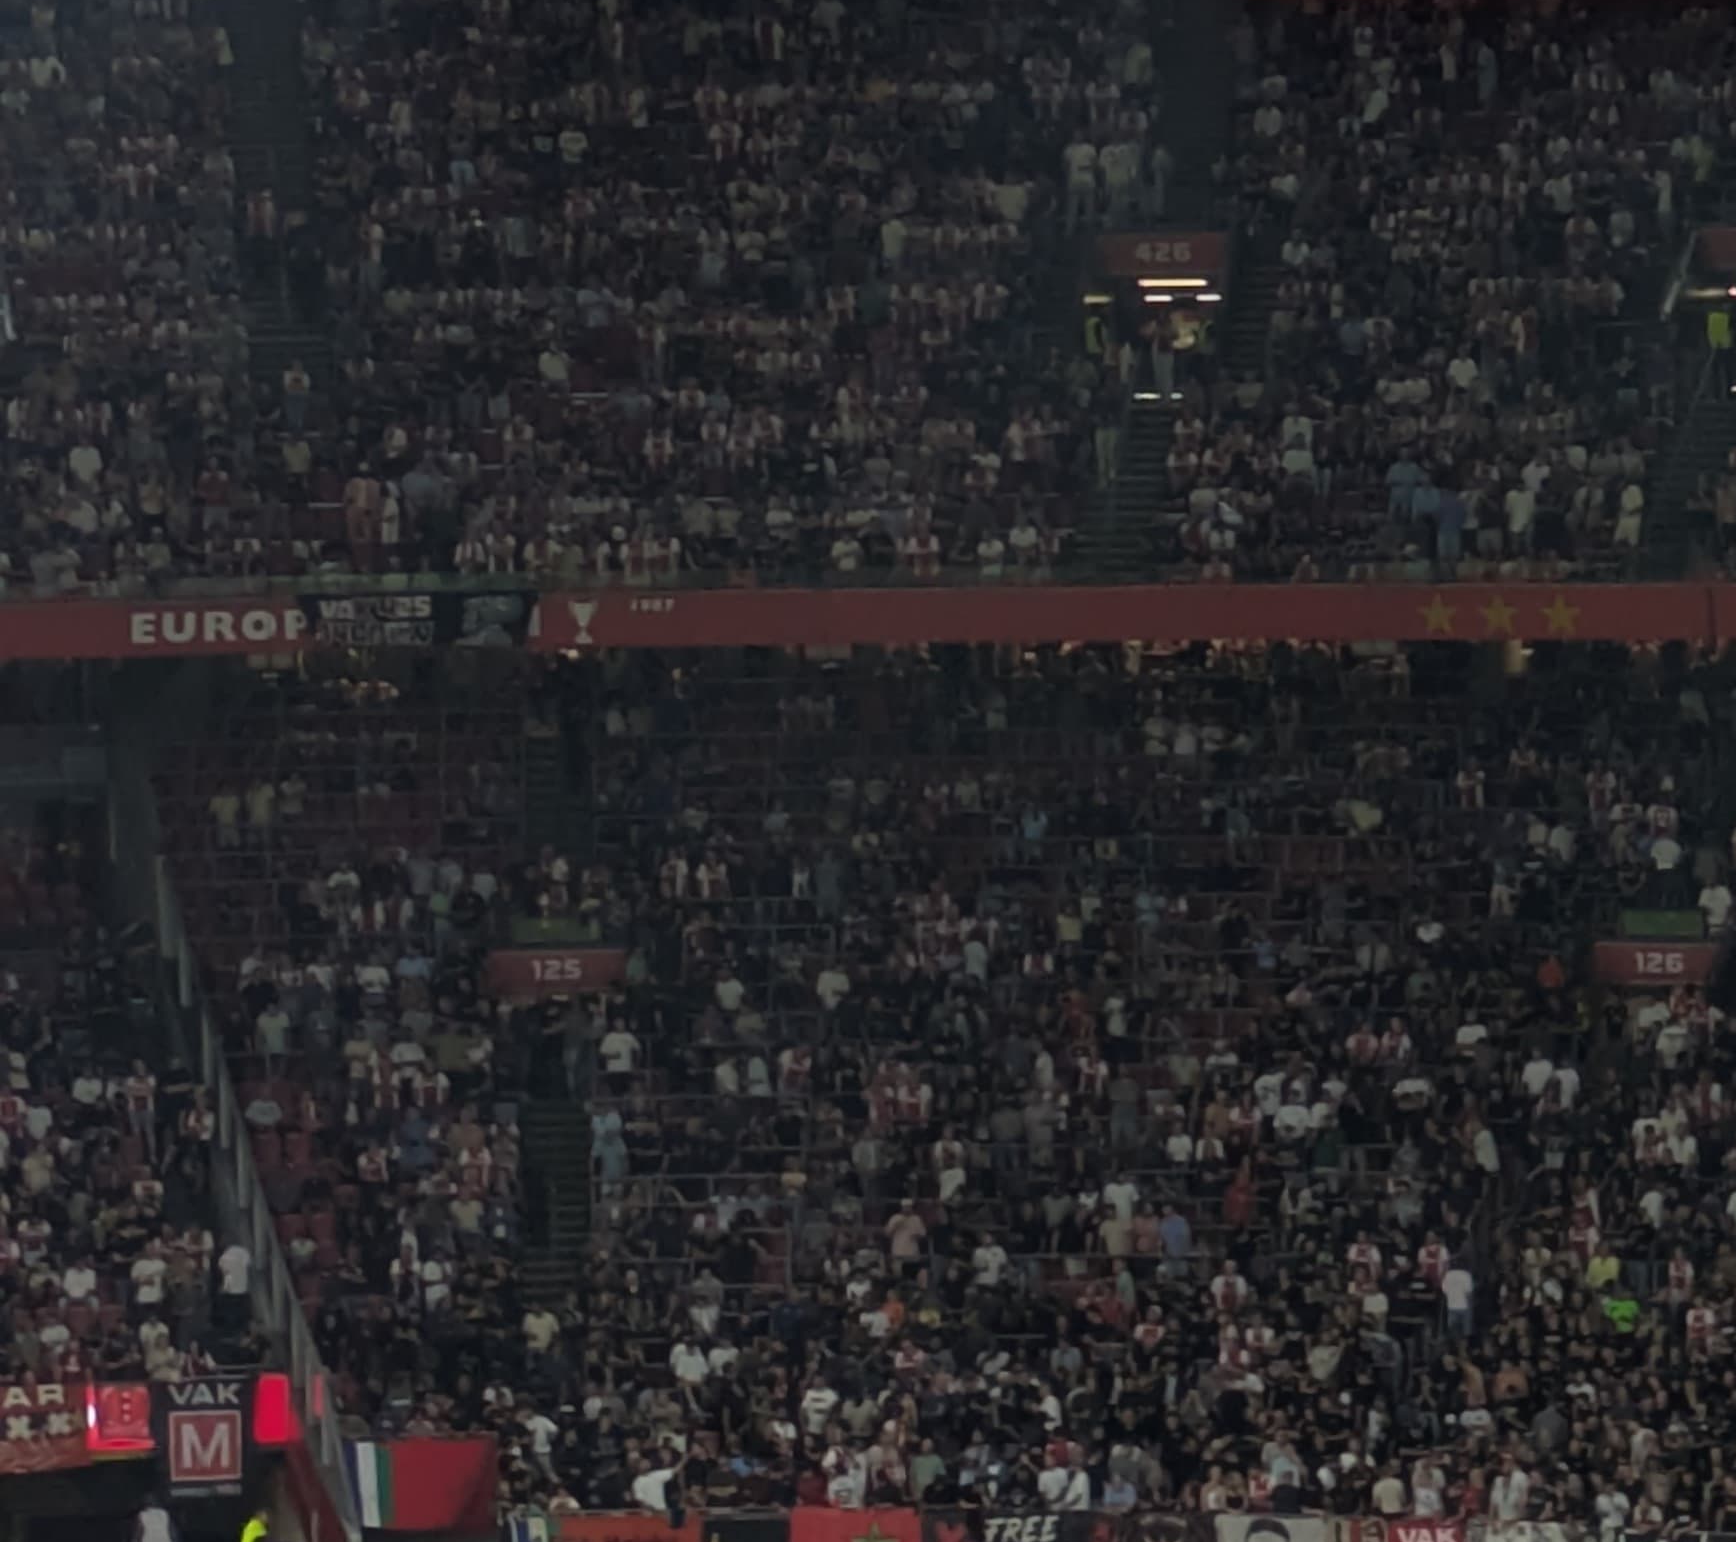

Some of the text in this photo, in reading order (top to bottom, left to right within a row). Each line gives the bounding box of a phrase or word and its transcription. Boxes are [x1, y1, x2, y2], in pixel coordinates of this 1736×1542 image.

[1135, 240, 1193, 263] 426
[131, 607, 309, 645] EUROP
[531, 958, 583, 981] 125
[1634, 950, 1685, 974] 126
[167, 1382, 241, 1406] VAK
[179, 1421, 232, 1469] M
